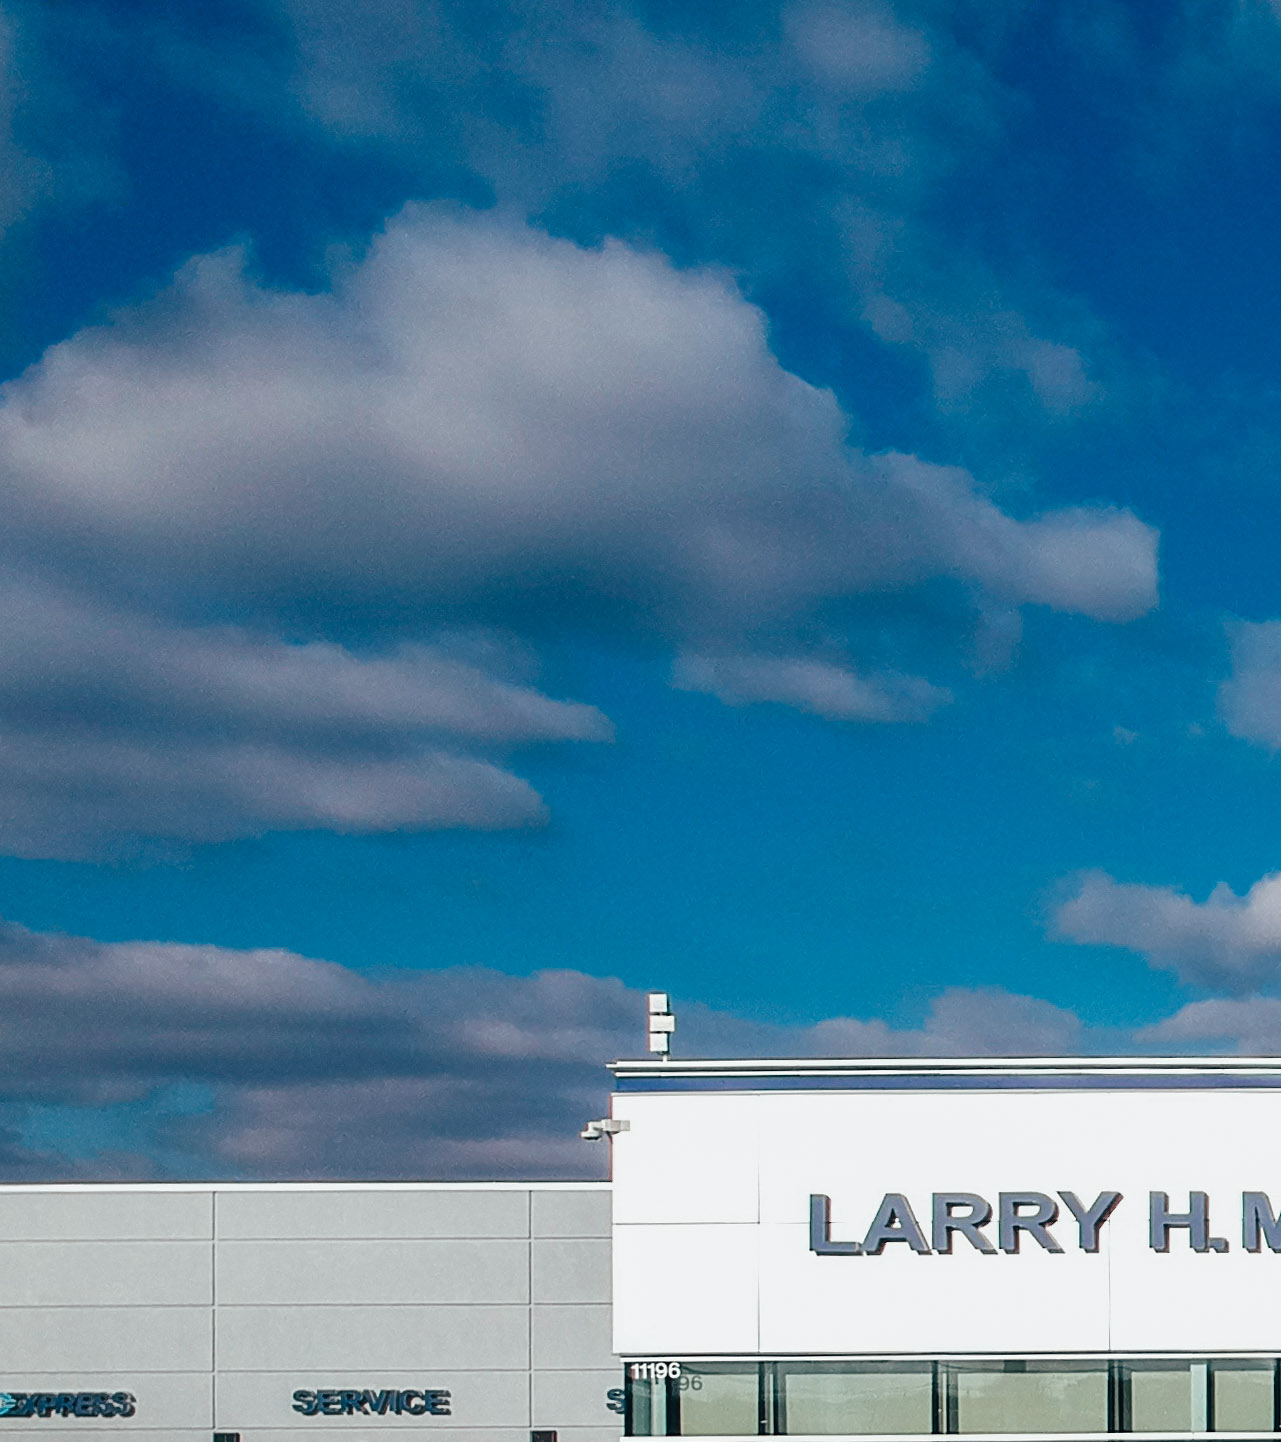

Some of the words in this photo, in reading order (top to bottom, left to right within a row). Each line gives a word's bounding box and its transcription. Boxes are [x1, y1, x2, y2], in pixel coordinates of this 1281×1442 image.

[809, 1191, 1124, 1256] LARRY
[1149, 1191, 1230, 1254] H.
[630, 1362, 681, 1380] 11196
[292, 1389, 452, 1416] SERVICE
